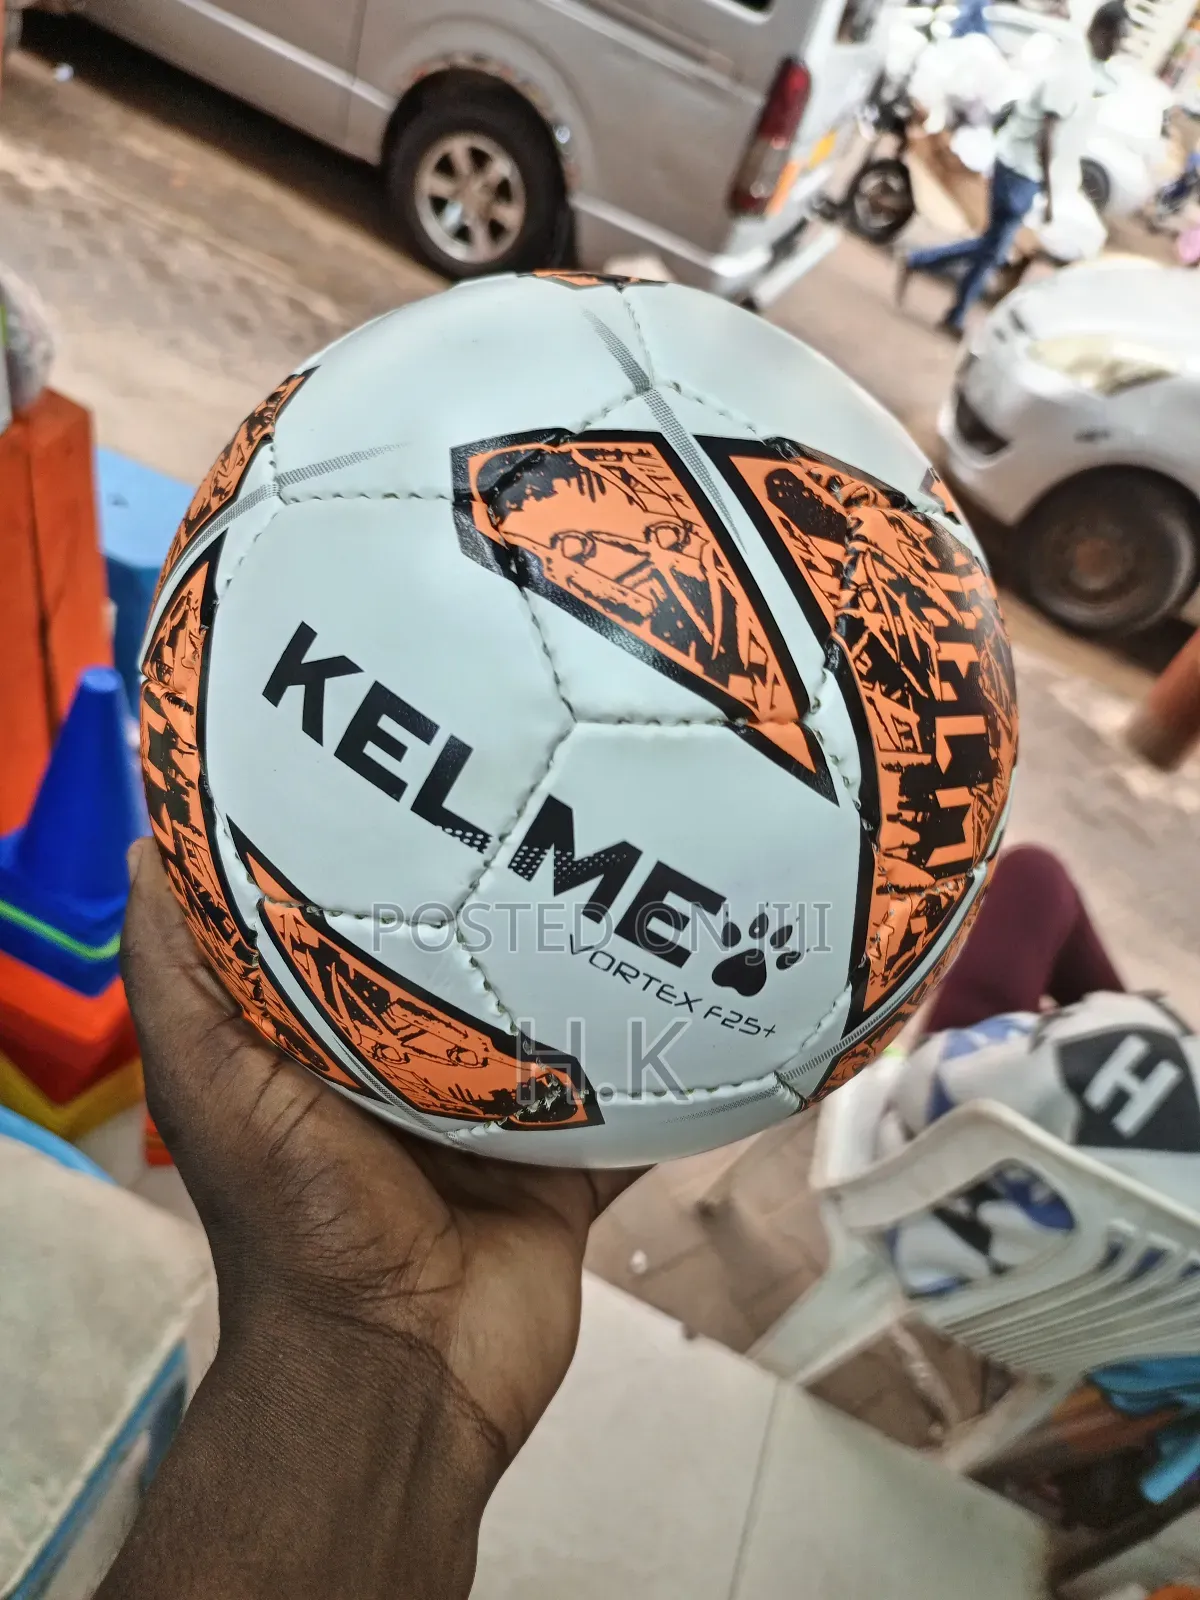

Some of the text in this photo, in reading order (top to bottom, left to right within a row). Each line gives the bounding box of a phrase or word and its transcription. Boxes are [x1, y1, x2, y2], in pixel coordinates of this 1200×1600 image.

[262, 621, 727, 969] KELME
[570, 934, 776, 1038] VORTEX F25+
[1083, 1035, 1182, 1139] H
